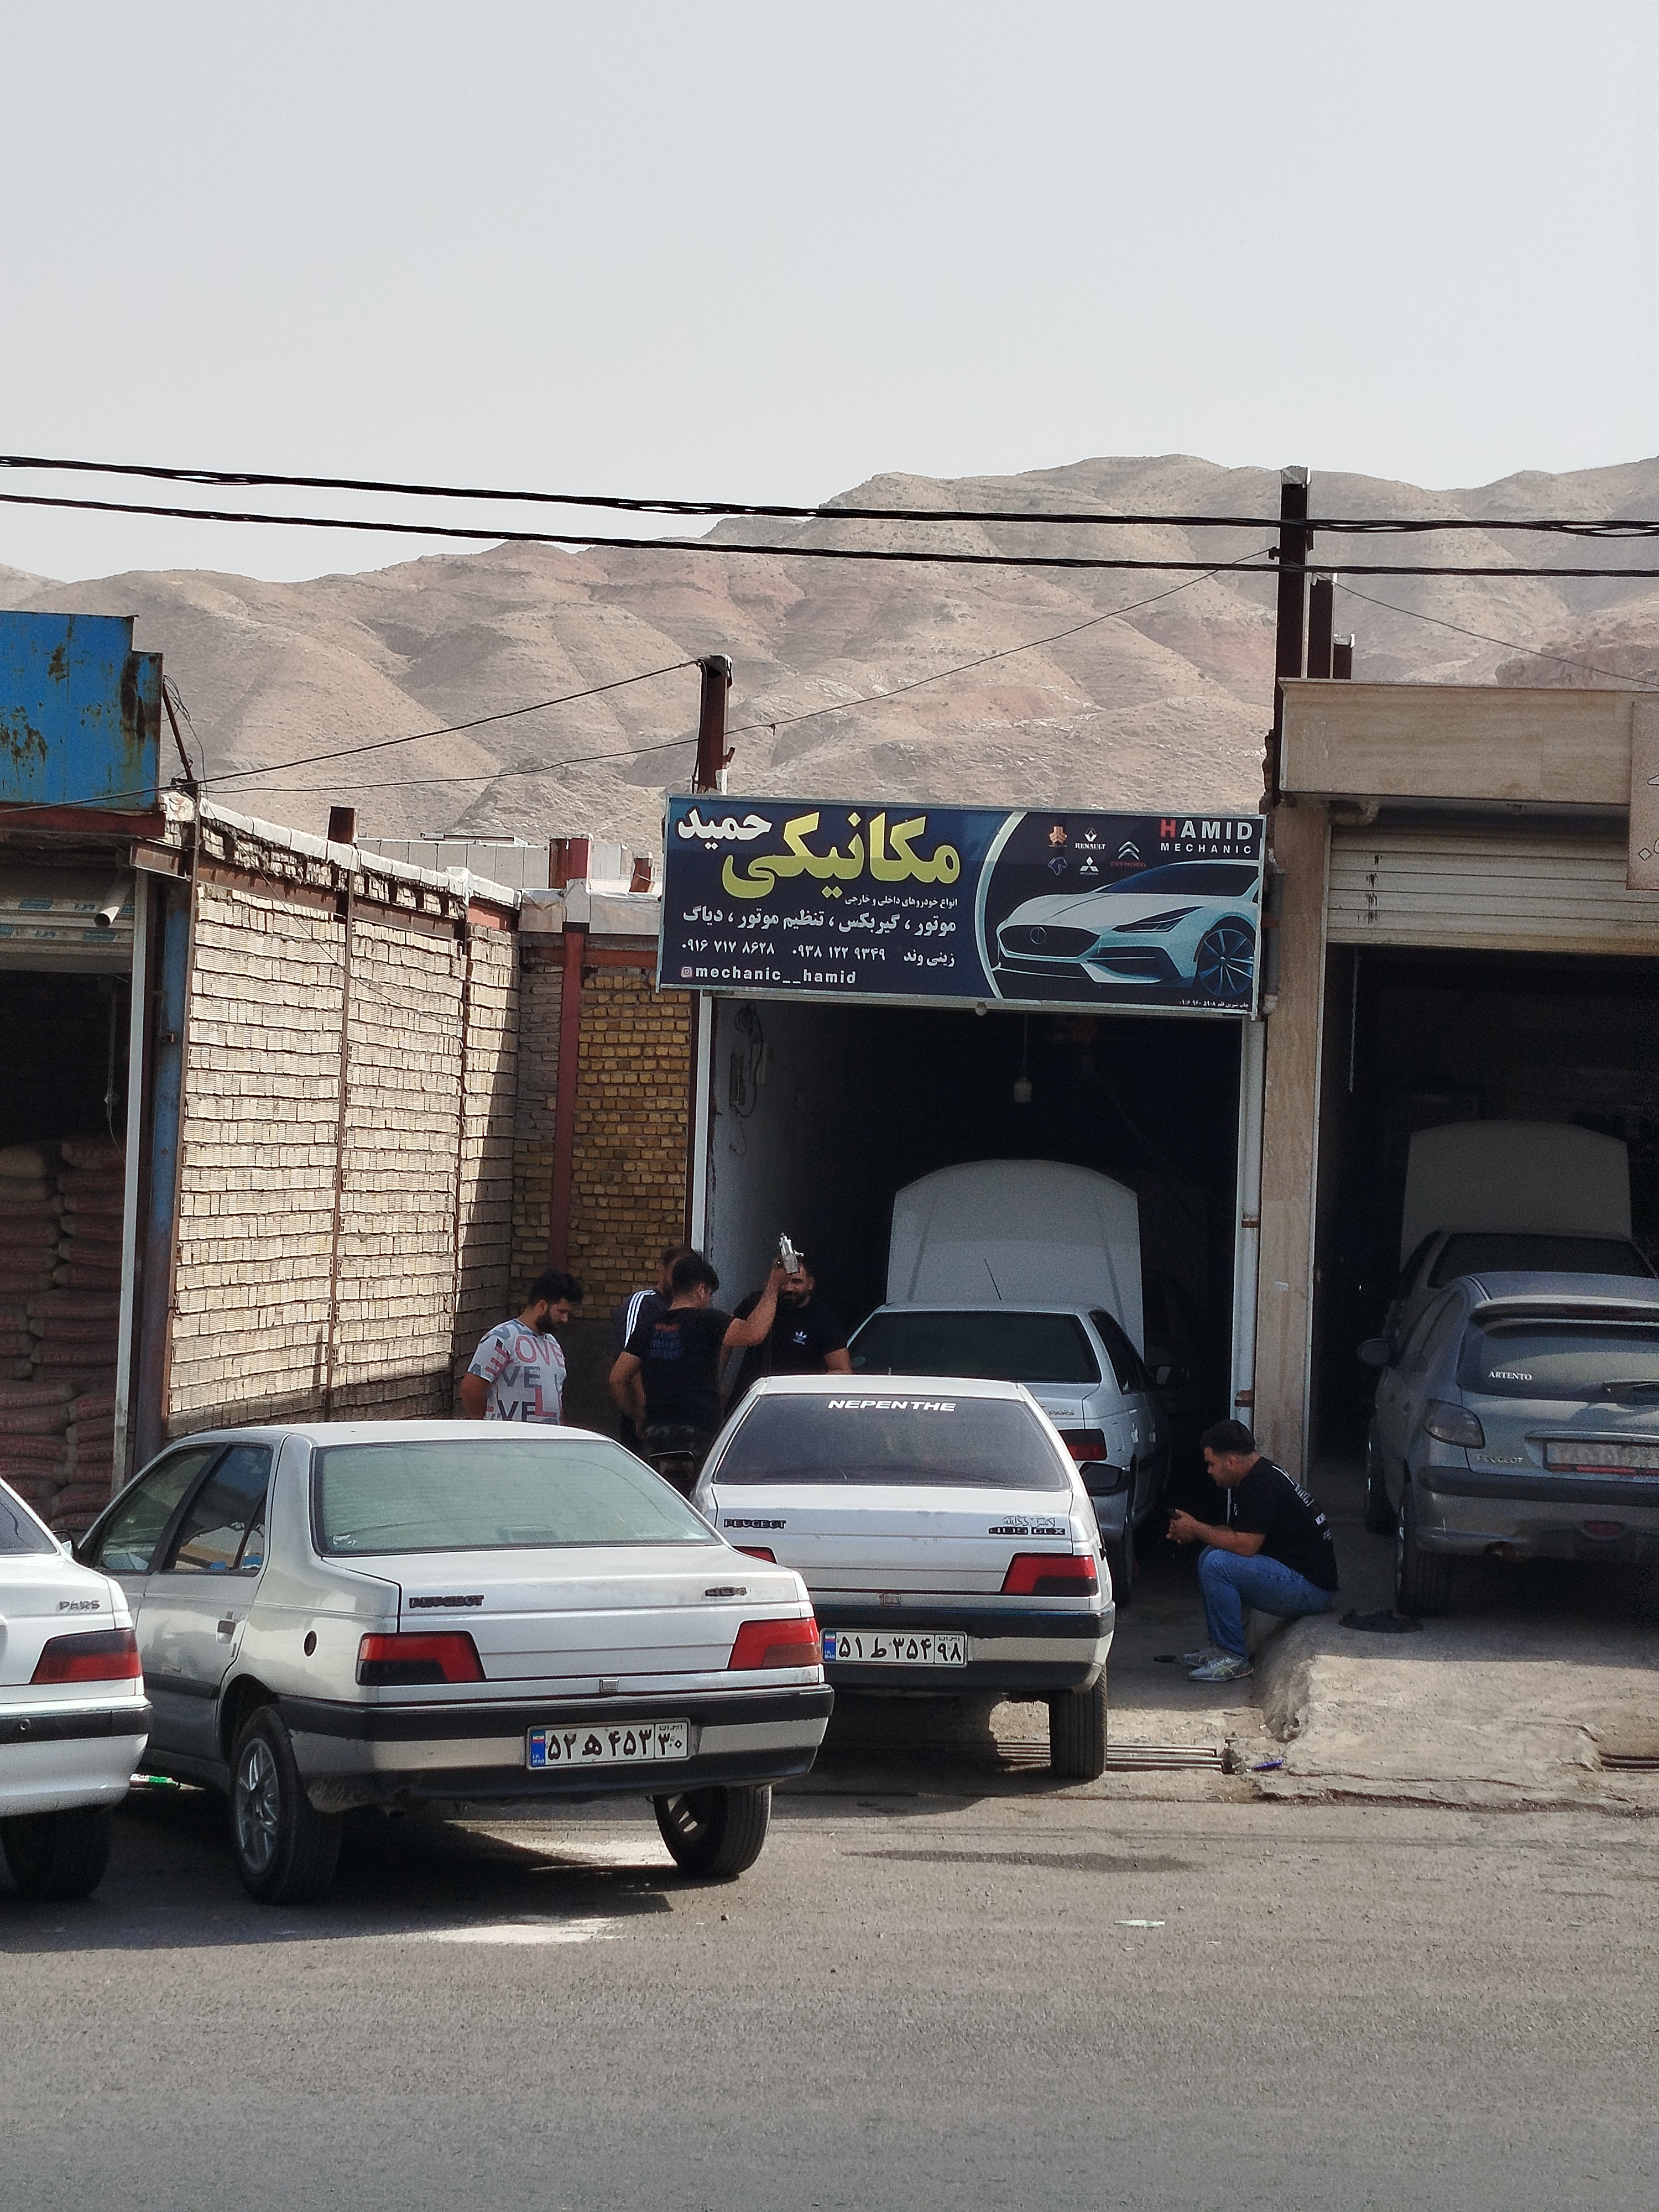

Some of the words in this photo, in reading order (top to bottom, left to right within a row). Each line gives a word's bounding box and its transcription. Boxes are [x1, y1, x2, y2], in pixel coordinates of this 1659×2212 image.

[678, 808, 772, 850] حمید
[1160, 819, 1253, 839] HAMID
[722, 811, 961, 899] مکانیکی
[1161, 843, 1251, 853] MECHANIC
[845, 894, 870, 905] خارجی
[872, 898, 876, 906] و
[878, 895, 900, 906] داخلی
[901, 897, 938, 908] خودروهای
[940, 898, 958, 909] انواع
[683, 905, 723, 926] دیاگ
[737, 907, 779, 929] موتور
[783, 909, 825, 930] تنظیم
[838, 912, 900, 934] گیربکس
[914, 915, 956, 936] موتور
[682, 938, 708, 952] ۰۹۱۶
[714, 940, 737, 953] ۷۱۷
[742, 941, 775, 954] ۸۶۲۸
[792, 945, 822, 958] ۰۹۳۸
[829, 946, 848, 959] ۱۲۲
[854, 947, 885, 961] ۹۳۴۹
[904, 949, 924, 966] وند
[926, 951, 955, 967] زینی
[1488, 1371, 1532, 1381] ARTENTO
[723, 1519, 786, 1529] PEUGEOT
[937, 1642, 962, 1661] ۹۸
